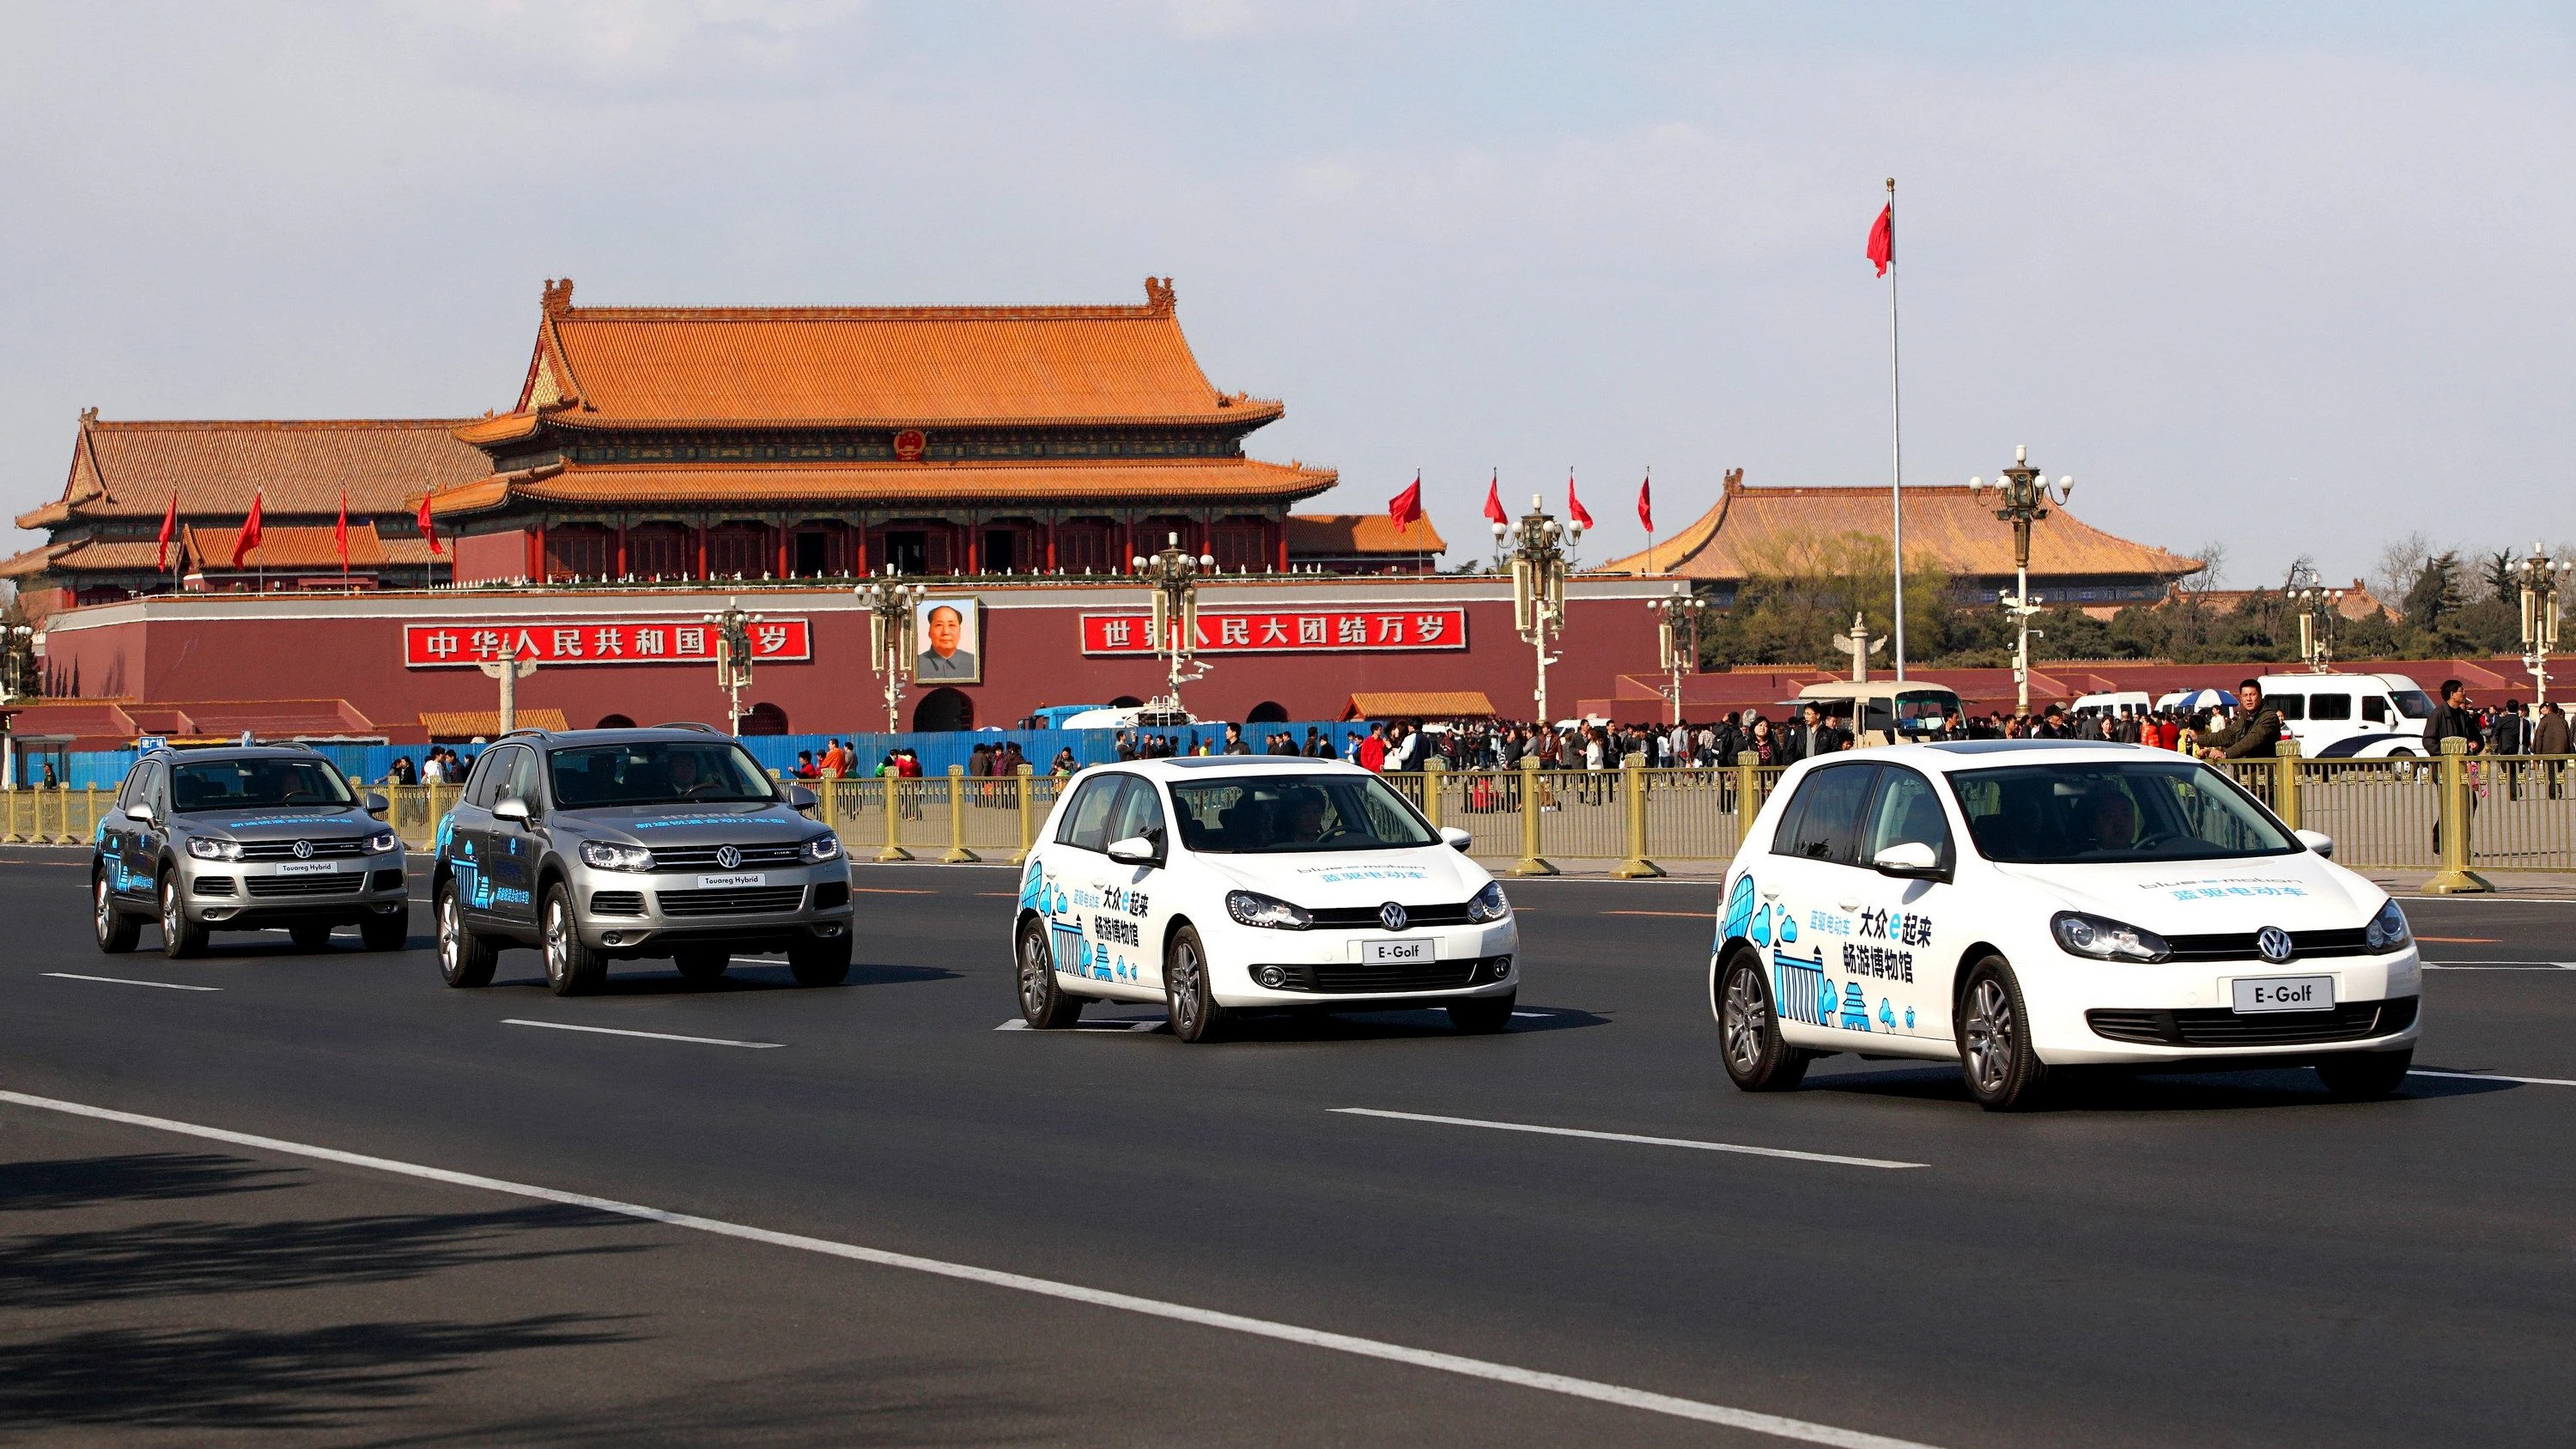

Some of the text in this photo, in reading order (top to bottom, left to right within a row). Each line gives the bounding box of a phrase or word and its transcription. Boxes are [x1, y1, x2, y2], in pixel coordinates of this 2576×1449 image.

[427, 625, 788, 659] 中华人民共和国岁
[1103, 615, 1445, 648] 世民大团结万岁
[735, 876, 758, 885] Hybrid
[2171, 886, 2308, 901] 蓝驱电动车
[1103, 885, 1150, 918] 大众e起来
[1095, 915, 1139, 948] 畅游博物馆
[1809, 910, 1851, 937] 蓝驱电动车
[1859, 905, 1932, 948] 大众e起来
[1378, 945, 1419, 959] E-Golf
[1843, 941, 1913, 984] 畅游博物馆
[2255, 984, 2312, 1003] E-Golf
